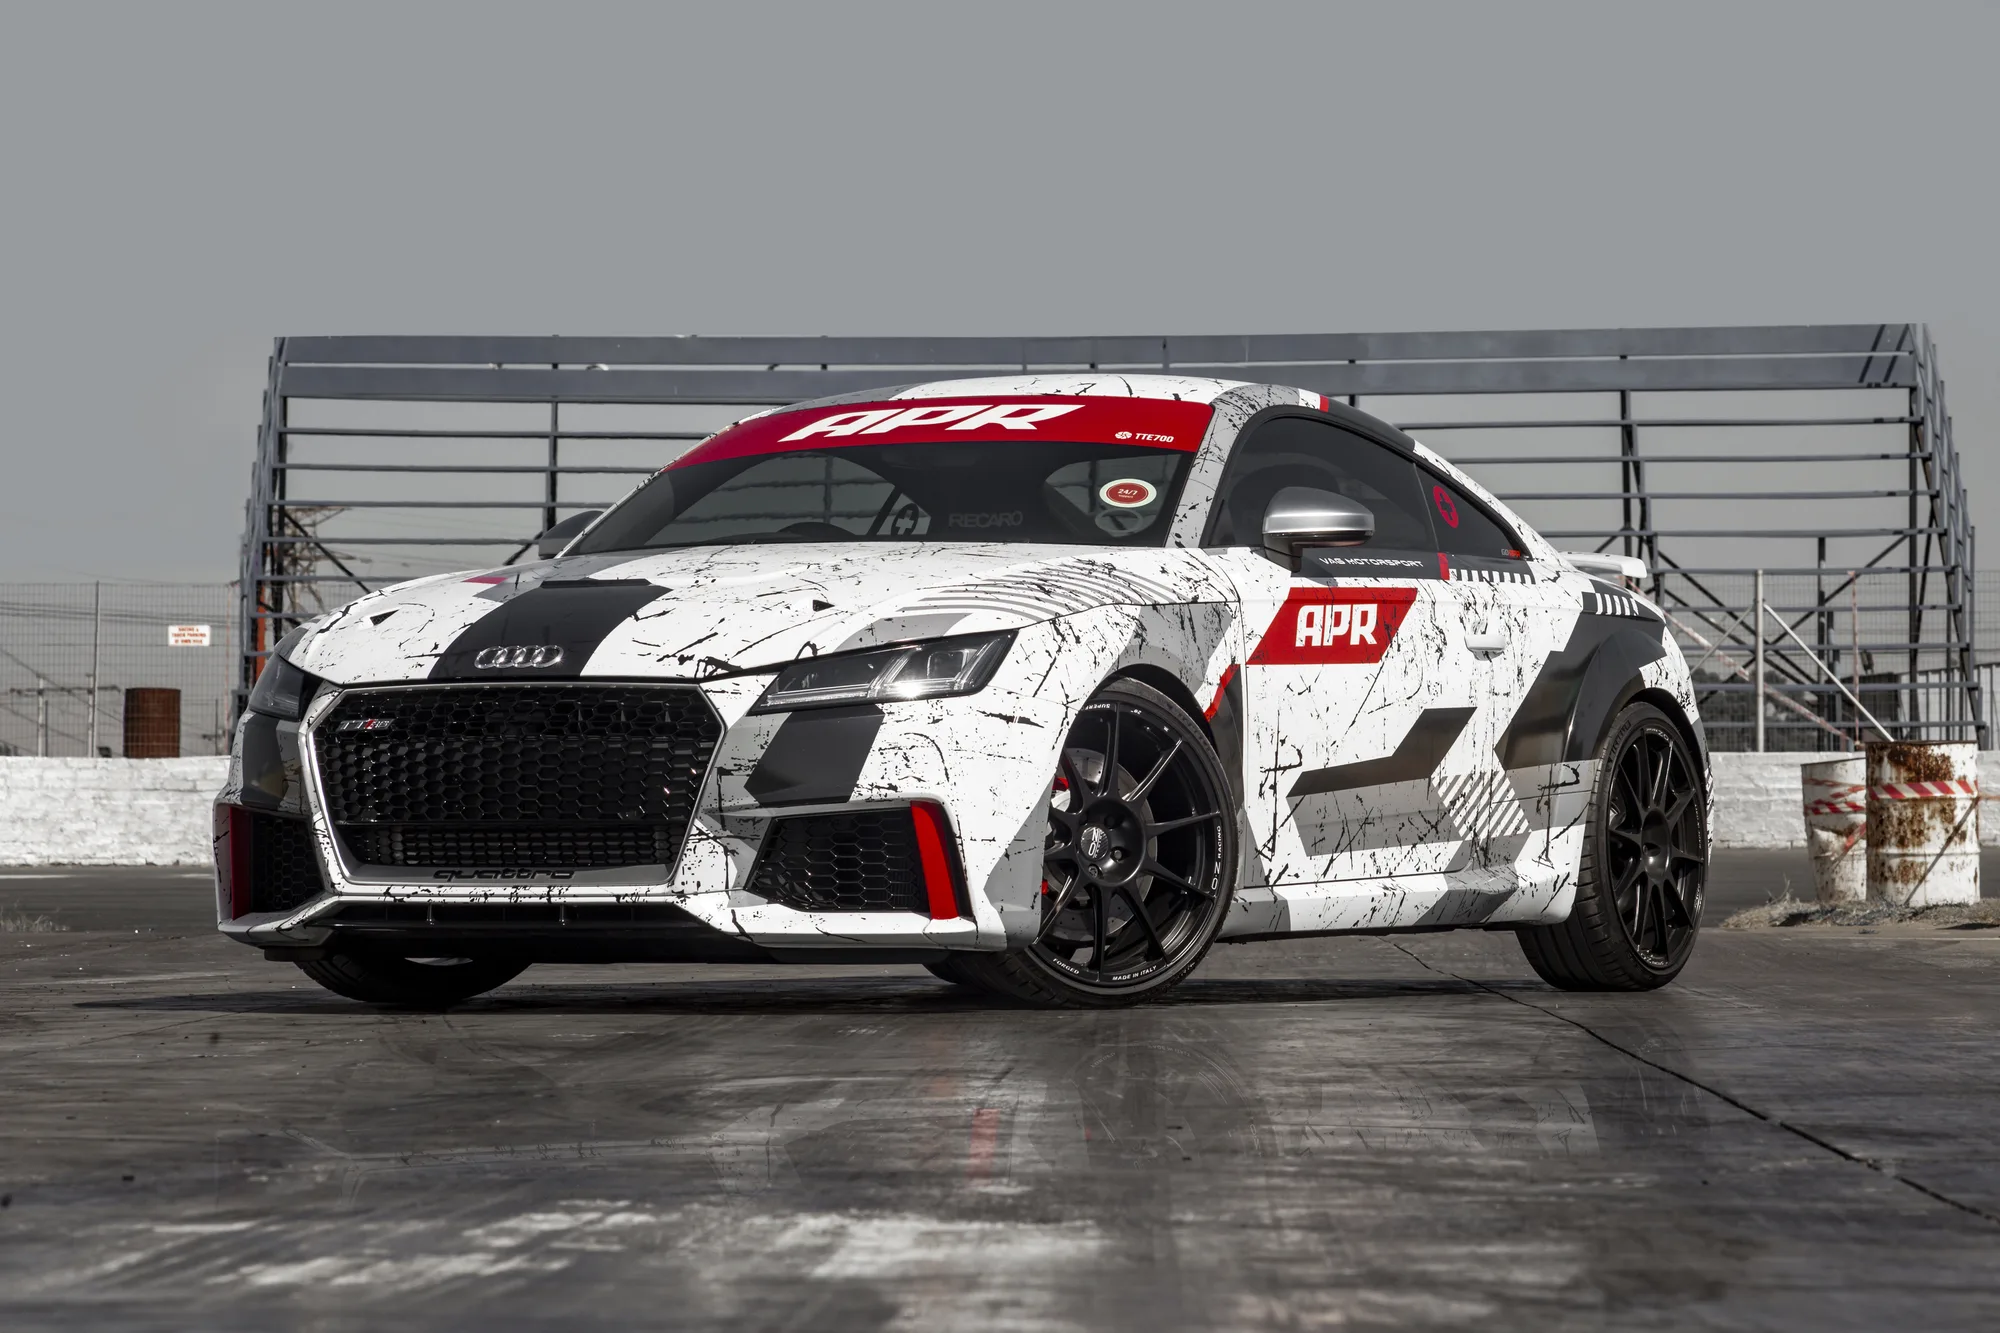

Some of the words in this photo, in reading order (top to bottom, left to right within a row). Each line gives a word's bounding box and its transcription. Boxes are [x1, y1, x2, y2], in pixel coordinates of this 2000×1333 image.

[777, 404, 1086, 443] APR
[1135, 432, 1175, 443] TTE700
[949, 510, 1024, 529] RECARO
[1344, 558, 1424, 568] MOTORSPORT
[1295, 603, 1378, 647] APR
[432, 868, 575, 883] quattro
[1052, 958, 1080, 975] FORGED
[1140, 965, 1157, 976] ITALY
